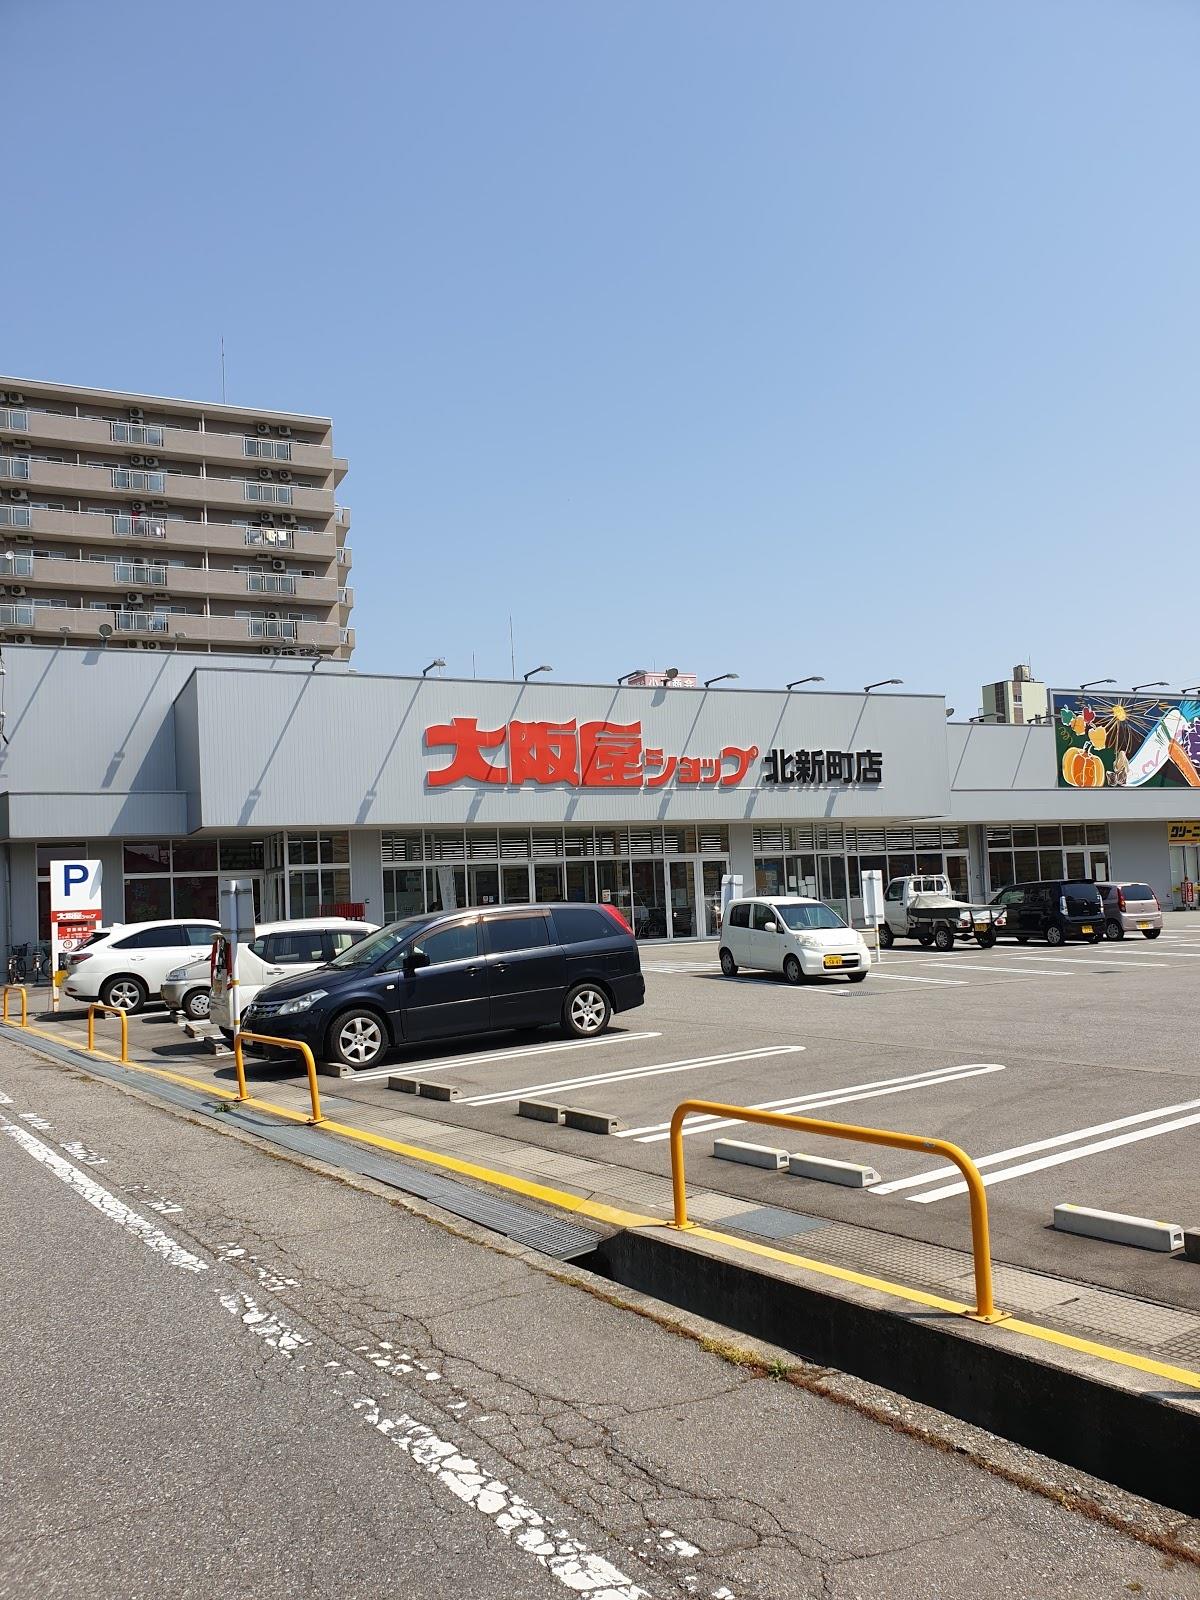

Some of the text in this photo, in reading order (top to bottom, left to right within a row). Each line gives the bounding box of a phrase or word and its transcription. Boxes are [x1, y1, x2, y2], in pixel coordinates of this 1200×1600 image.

[425, 717, 884, 788] 大阪屋ショップ 北新町店
[64, 865, 89, 896] P
